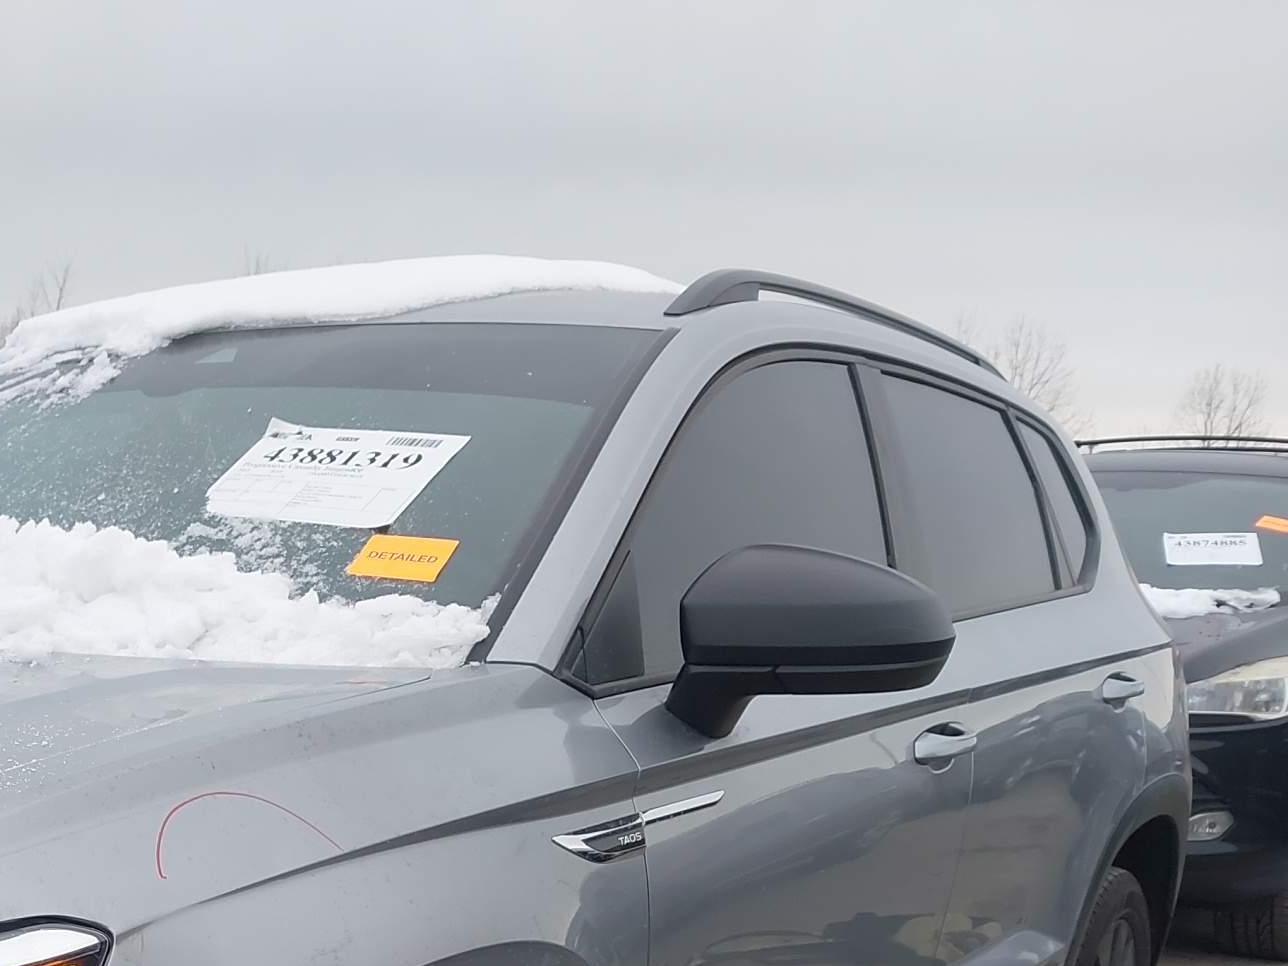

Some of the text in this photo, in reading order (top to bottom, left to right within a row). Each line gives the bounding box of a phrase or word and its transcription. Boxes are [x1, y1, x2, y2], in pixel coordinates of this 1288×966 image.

[262, 446, 424, 471] 43881319
[366, 550, 439, 565] DETAILED
[617, 831, 643, 847] TAOS
